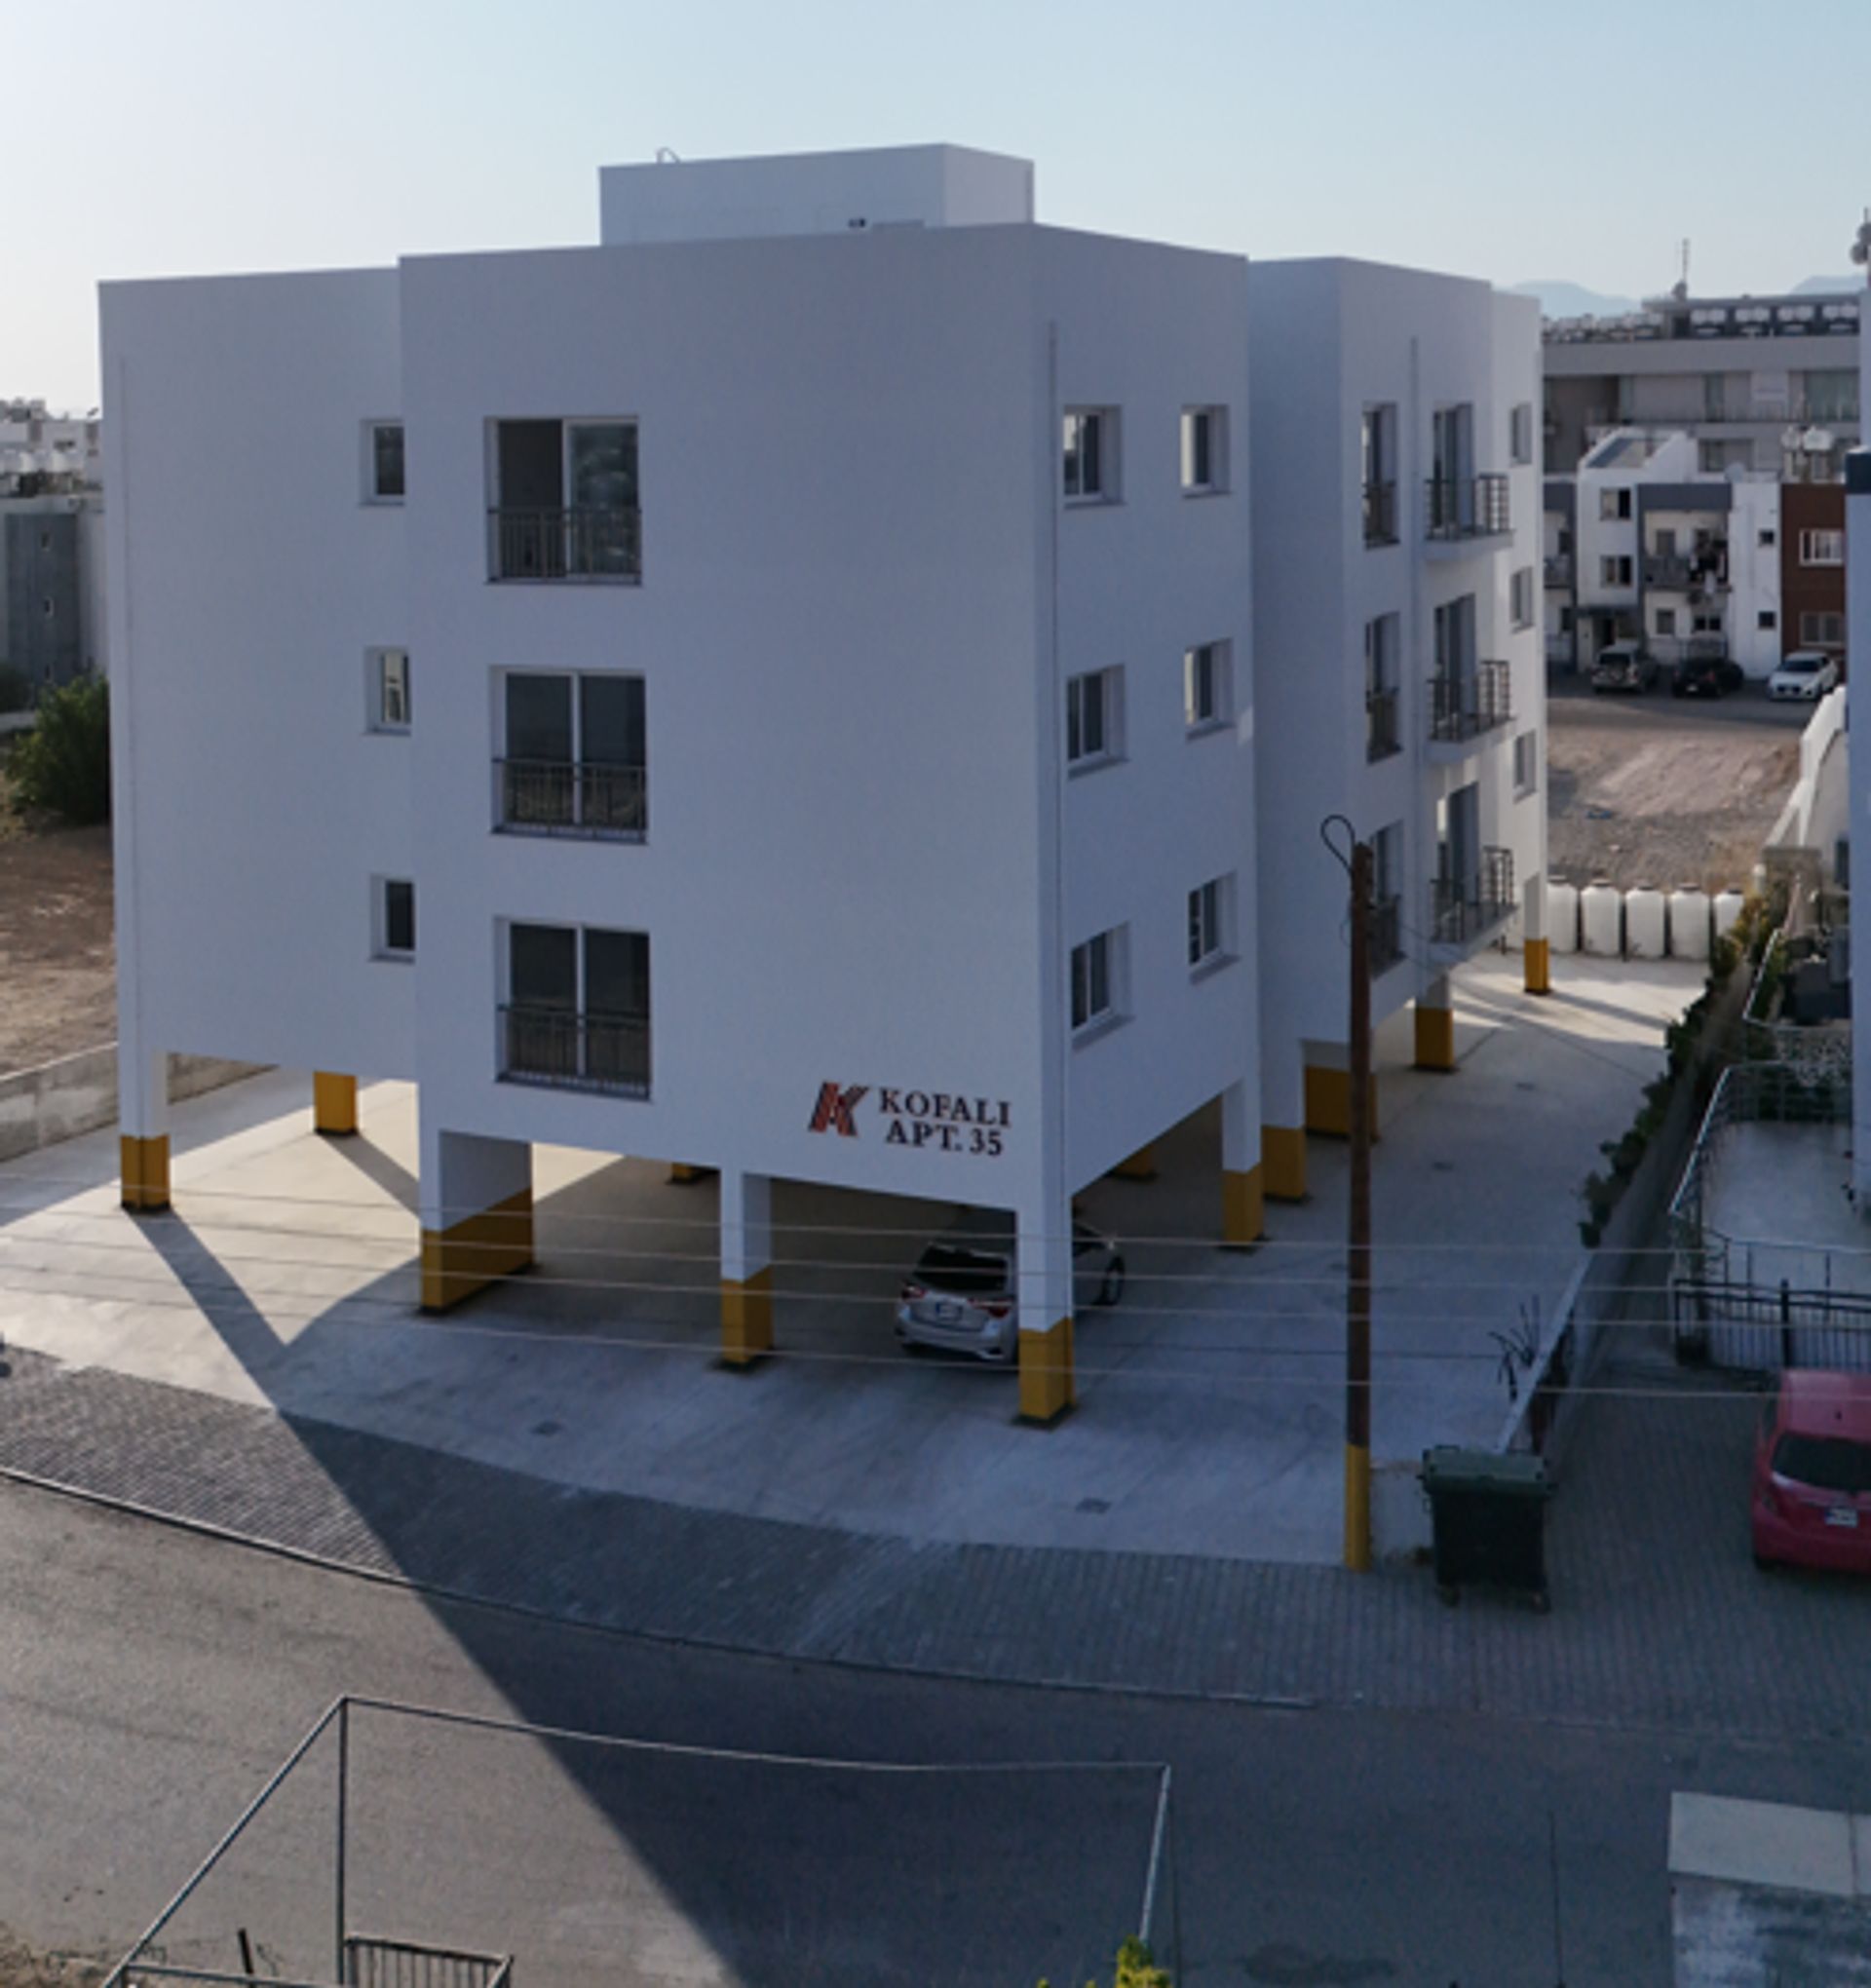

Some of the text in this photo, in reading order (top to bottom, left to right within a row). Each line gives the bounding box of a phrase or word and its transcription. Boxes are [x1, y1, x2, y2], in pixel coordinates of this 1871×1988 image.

[879, 1087, 1011, 1127] KOFALI
[885, 1120, 1003, 1157] APT. 35
